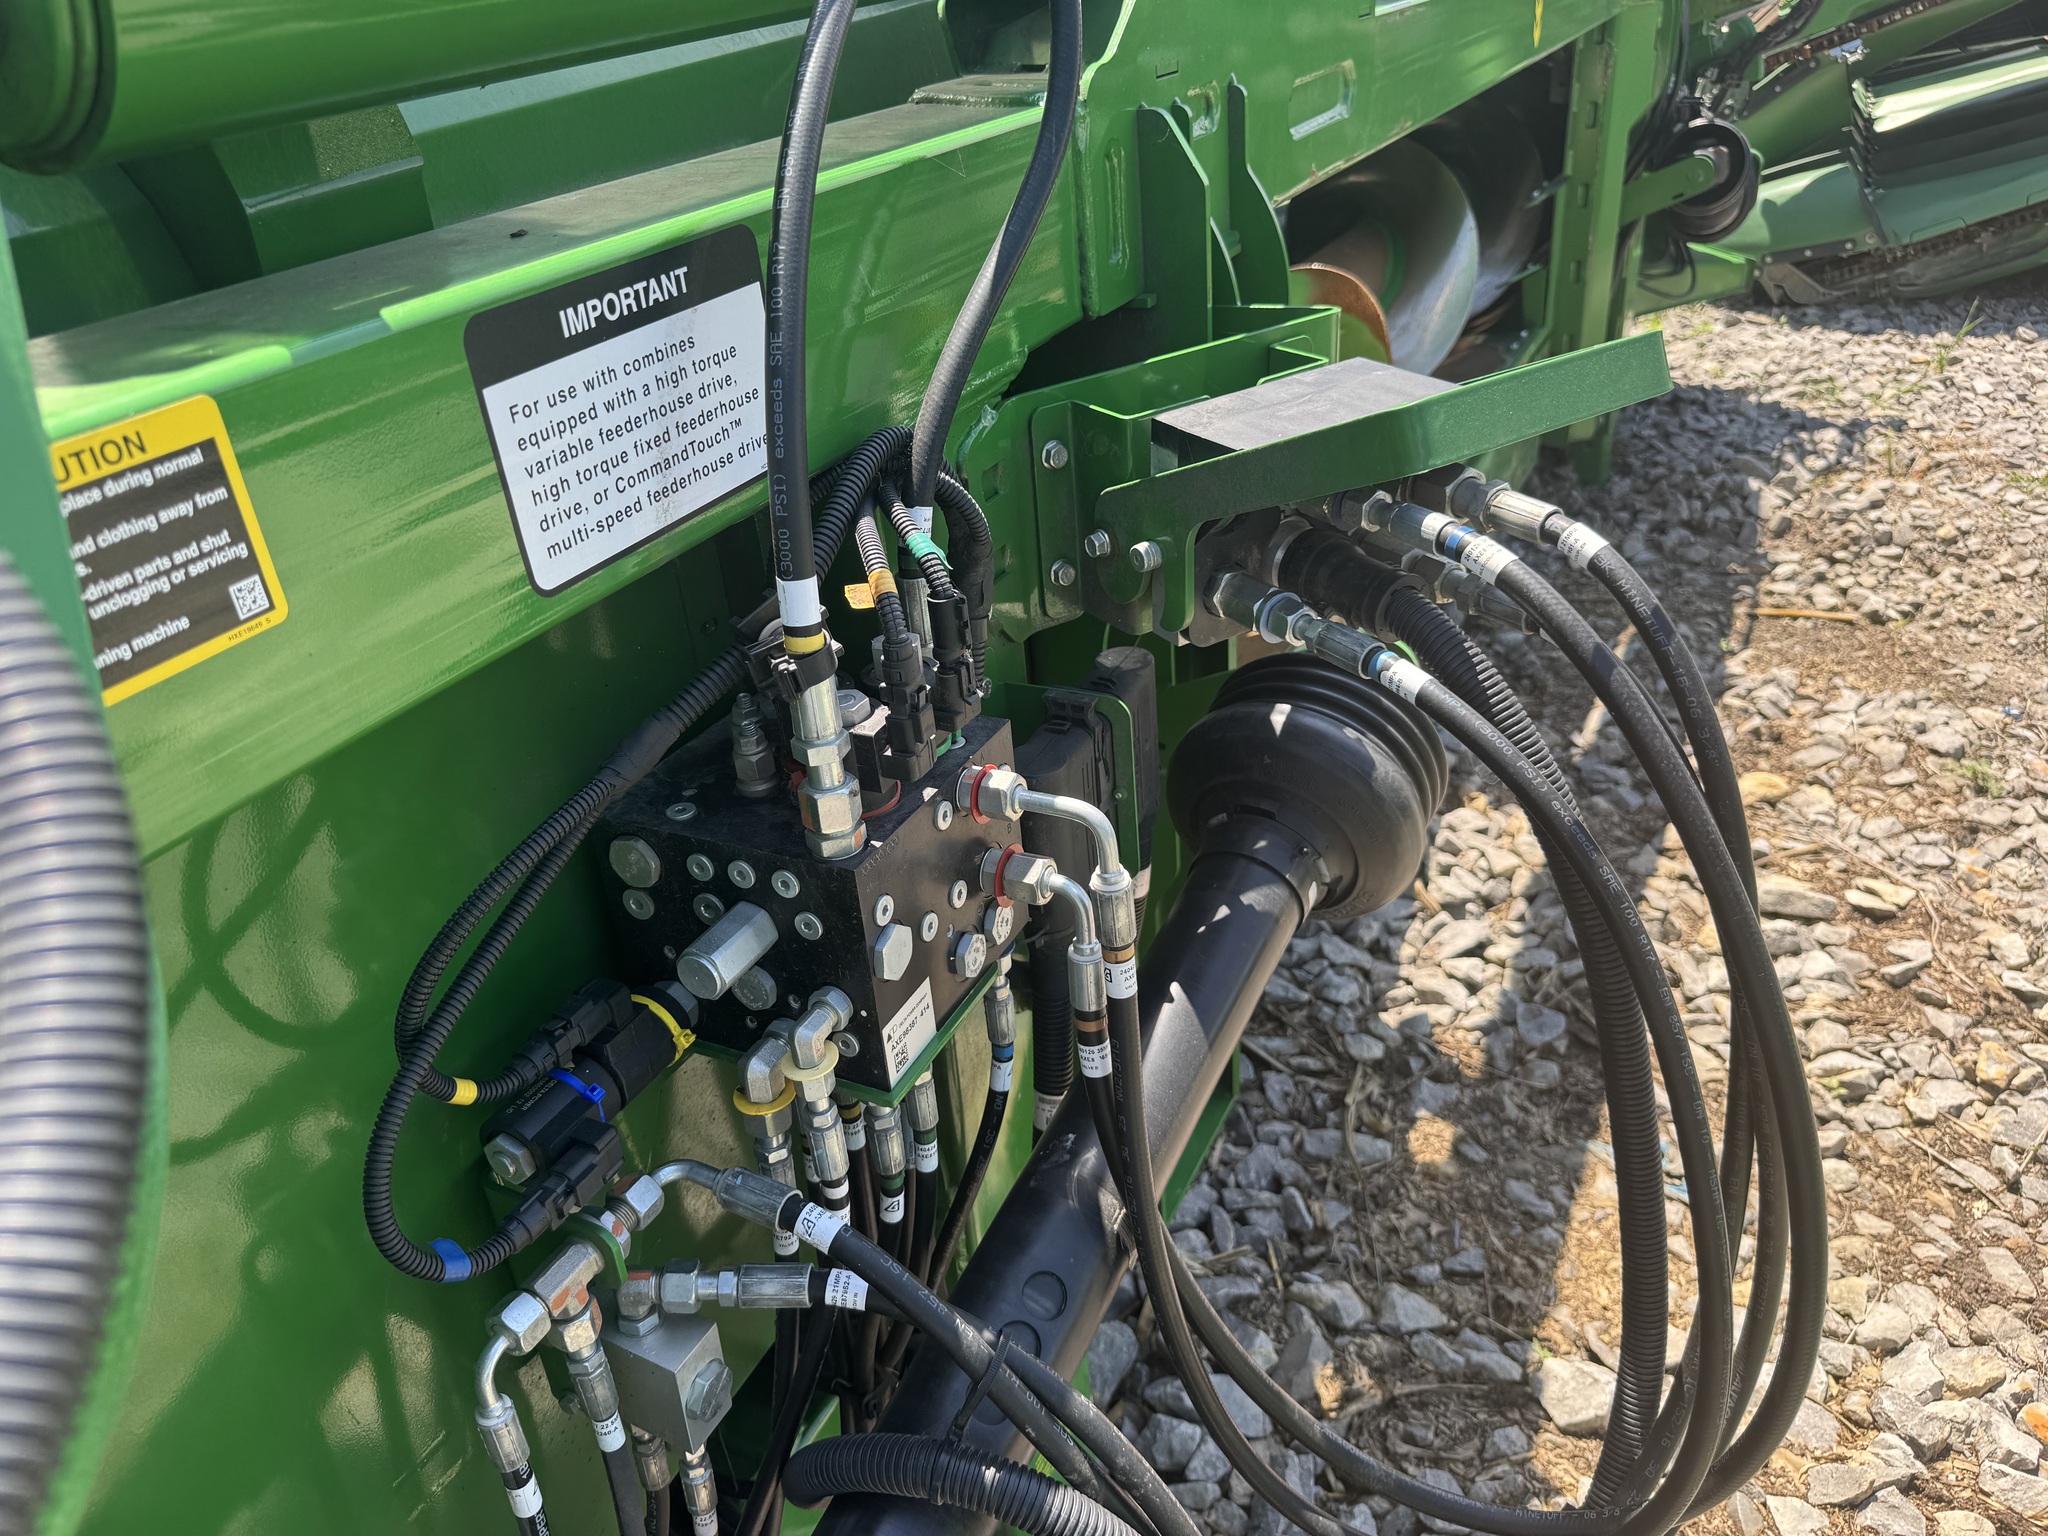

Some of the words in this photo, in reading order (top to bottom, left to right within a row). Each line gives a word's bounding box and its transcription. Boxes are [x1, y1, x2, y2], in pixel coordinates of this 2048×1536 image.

[777, 187, 791, 209] EN
[772, 242, 786, 275] R17
[559, 266, 688, 339] IMPORTANT
[771, 287, 784, 318] 100
[770, 331, 783, 367] SAE
[508, 401, 539, 424] For
[546, 384, 578, 410] use
[582, 366, 618, 398] with
[623, 335, 696, 376] combines
[516, 403, 599, 451] equipped
[602, 389, 638, 414] with
[642, 383, 652, 396] a
[654, 364, 689, 392] high
[692, 345, 738, 380] torque
[524, 436, 595, 480] variable
[597, 392, 694, 447] feederhouse
[697, 373, 739, 400] drive,
[773, 378, 785, 458] exceeds
[531, 478, 571, 507] high
[575, 450, 630, 486] torque
[633, 427, 672, 458] fixed
[675, 386, 760, 439] feederhouse
[59, 487, 103, 519] place
[103, 465, 155, 499] during
[154, 447, 205, 478] normal
[539, 501, 590, 533] drive,
[593, 488, 610, 505] or
[546, 500, 643, 559] multi-speed
[645, 451, 735, 504] feederhouse
[775, 473, 788, 517] PSI)
[96, 513, 159, 549] clothing
[158, 499, 194, 526] away
[195, 486, 229, 510] from
[88, 580, 171, 621] unclogging
[170, 569, 187, 585] or
[188, 541, 249, 578] servicing
[133, 556, 172, 585] parts
[172, 540, 200, 564] and
[199, 528, 232, 553] shut
[778, 528, 794, 581] (3000
[131, 615, 190, 652] machine
[1473, 718, 1514, 757] (3000
[1516, 759, 1548, 793] PSI)
[1550, 799, 1599, 861] exceeds
[1598, 864, 1623, 895] SAE
[1620, 898, 1640, 928] 100
[1637, 933, 1656, 964] R17
[1658, 987, 1672, 1008] EN
[1668, 1014, 1685, 1041] 857
[917, 1289, 948, 1315] 857
[954, 1318, 973, 1339] EN
[1026, 1391, 1046, 1415] 100
[1053, 1422, 1074, 1446] SAE
